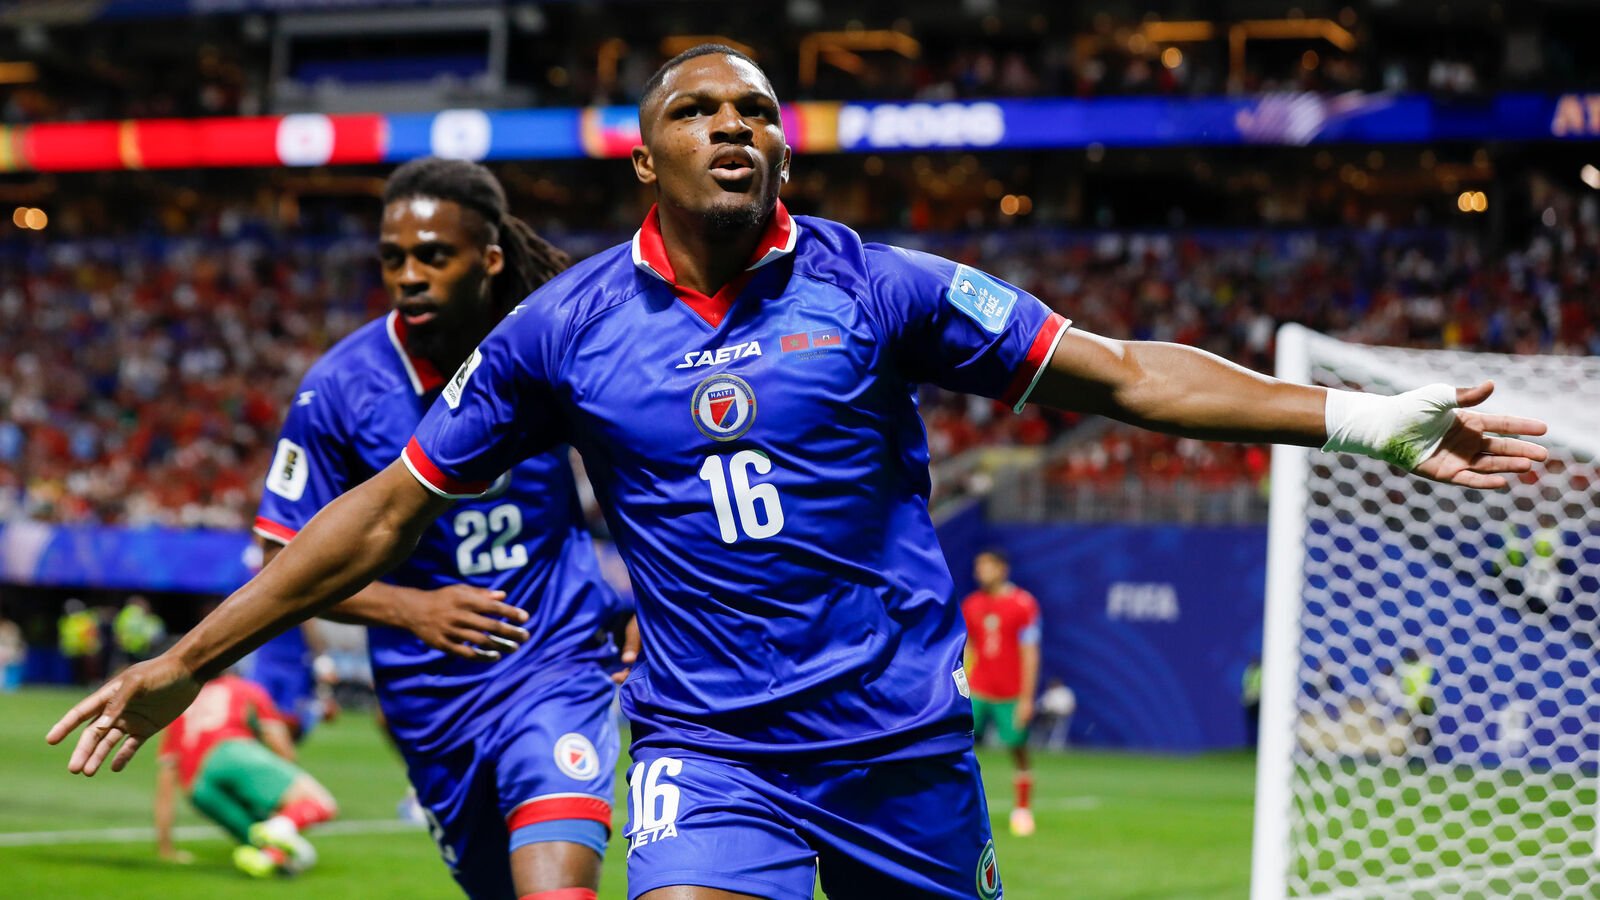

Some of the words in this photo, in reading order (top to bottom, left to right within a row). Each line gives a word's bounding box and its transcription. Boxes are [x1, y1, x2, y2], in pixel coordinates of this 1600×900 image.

[675, 341, 763, 368] SAETA
[710, 389, 733, 399] HAITI
[699, 449, 784, 544] 16
[454, 503, 528, 576] 22
[625, 757, 682, 838] 16
